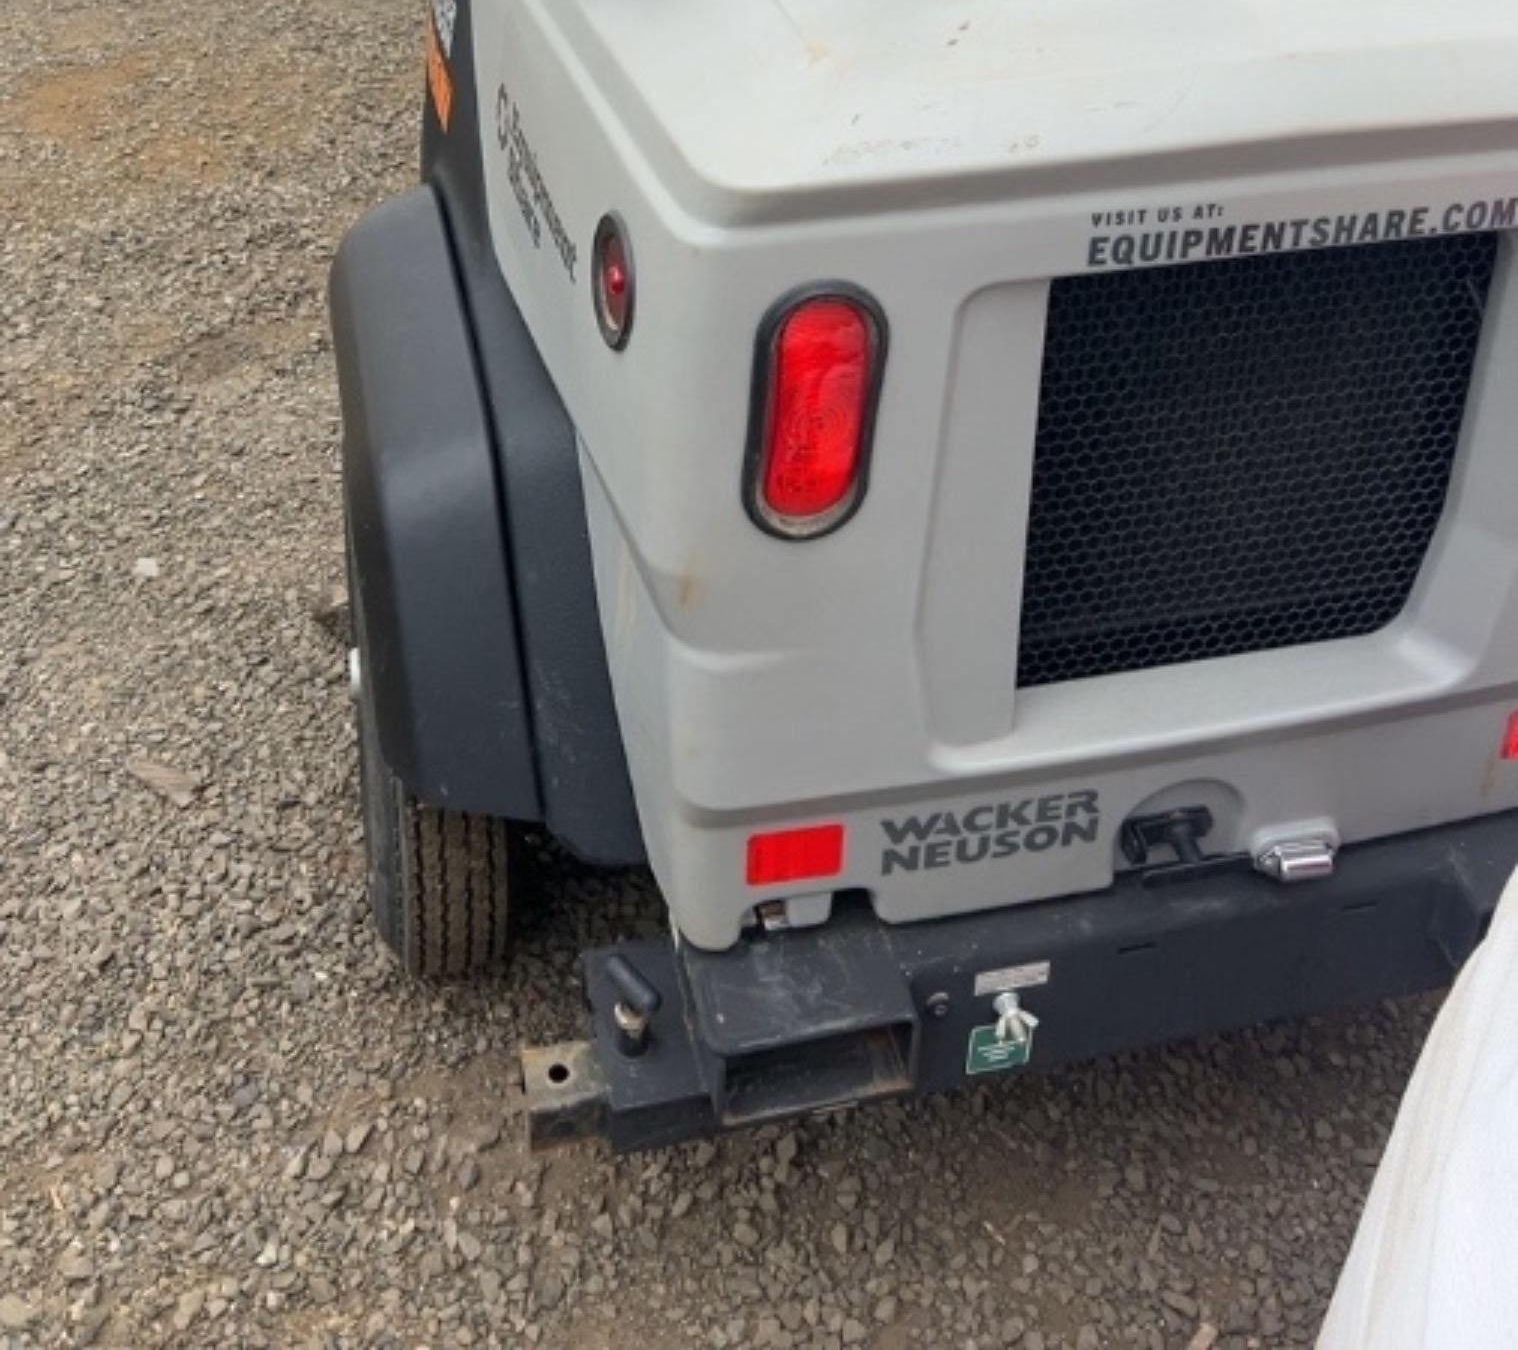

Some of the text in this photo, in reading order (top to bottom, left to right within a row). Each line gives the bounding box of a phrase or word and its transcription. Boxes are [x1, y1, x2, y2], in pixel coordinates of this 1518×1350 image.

[1087, 197, 1518, 267] EQUIPMENTSHARE.COM
[1091, 203, 1224, 227] VISIT US AT:
[880, 788, 1100, 845] WACKER
[880, 816, 1099, 877] NEUSON
